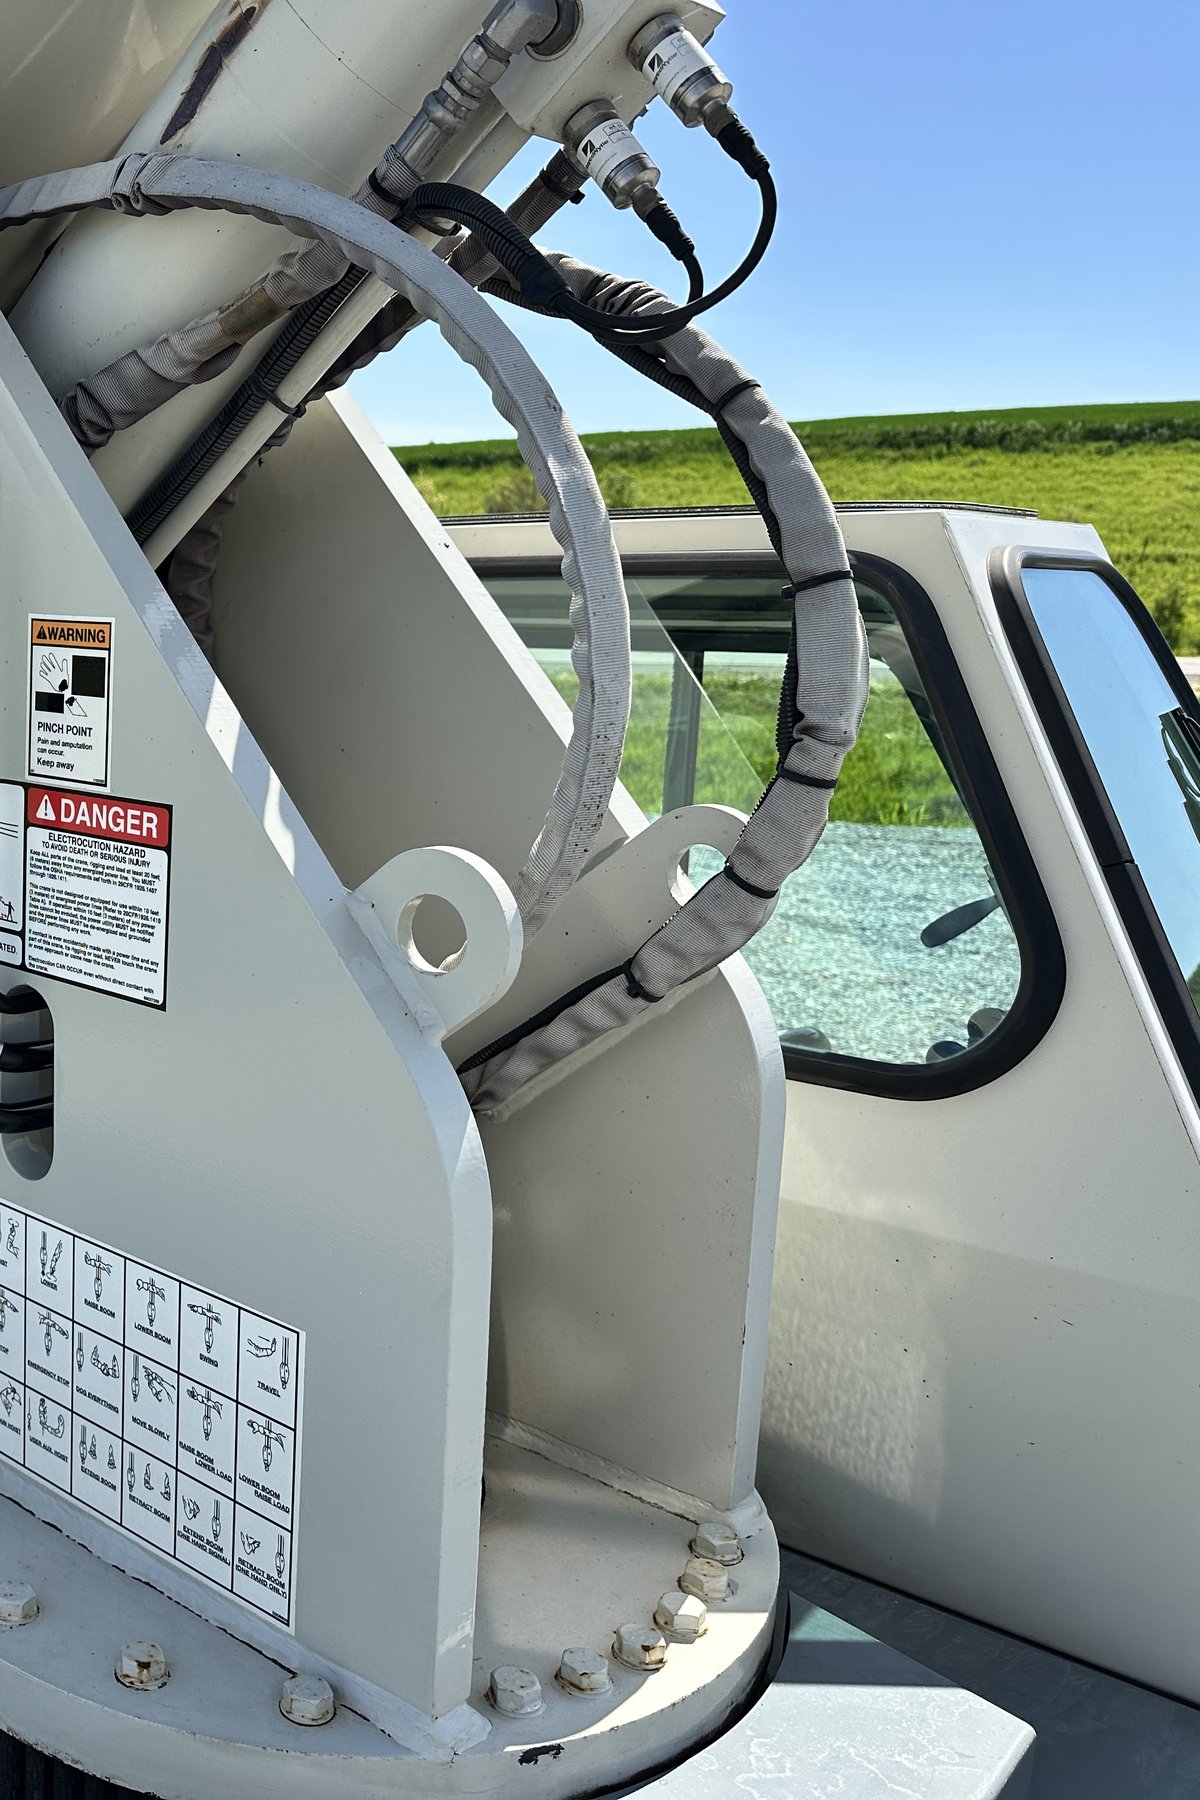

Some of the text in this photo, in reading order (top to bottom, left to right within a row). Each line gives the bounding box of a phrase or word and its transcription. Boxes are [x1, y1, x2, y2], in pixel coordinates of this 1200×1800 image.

[48, 627, 106, 643] WARNING
[37, 722, 92, 737] PINCH POINT
[61, 741, 92, 750] amputation
[37, 757, 74, 771] Keep away
[61, 798, 158, 839] DANGER
[42, 841, 150, 868] TO AVOID DEATH OR SERIOUS INJURY
[49, 832, 146, 858] ELECTROCUTION HAZARD
[40, 1277, 57, 1291] LOWER
[84, 1298, 115, 1318] RAISE BOOM
[134, 1322, 170, 1345] LOWER BOOM
[28, 1359, 69, 1387] EMERGENCY STOP
[199, 1352, 218, 1368] SWING
[76, 1385, 118, 1414] DOG EVERYTHING
[257, 1380, 280, 1397] TRAVEL
[132, 1415, 169, 1441] MOVE SLOWLY
[179, 1440, 213, 1464] RAISE BOOM
[80, 1464, 116, 1491] EXTEND BOOM
[195, 1457, 232, 1483] LOWER LOAD
[238, 1472, 279, 1500] LOWER BOOM
[128, 1492, 170, 1522] RETRACT BOOM
[254, 1489, 289, 1514] RAISE LOAD
[177, 1529, 230, 1566] (ONE HAND SIGNAL)
[183, 1524, 223, 1554] EXTEND BOOM
[235, 1563, 286, 1599] (ONE HAND ONLY)
[238, 1556, 284, 1590] RETRACT BOOM
